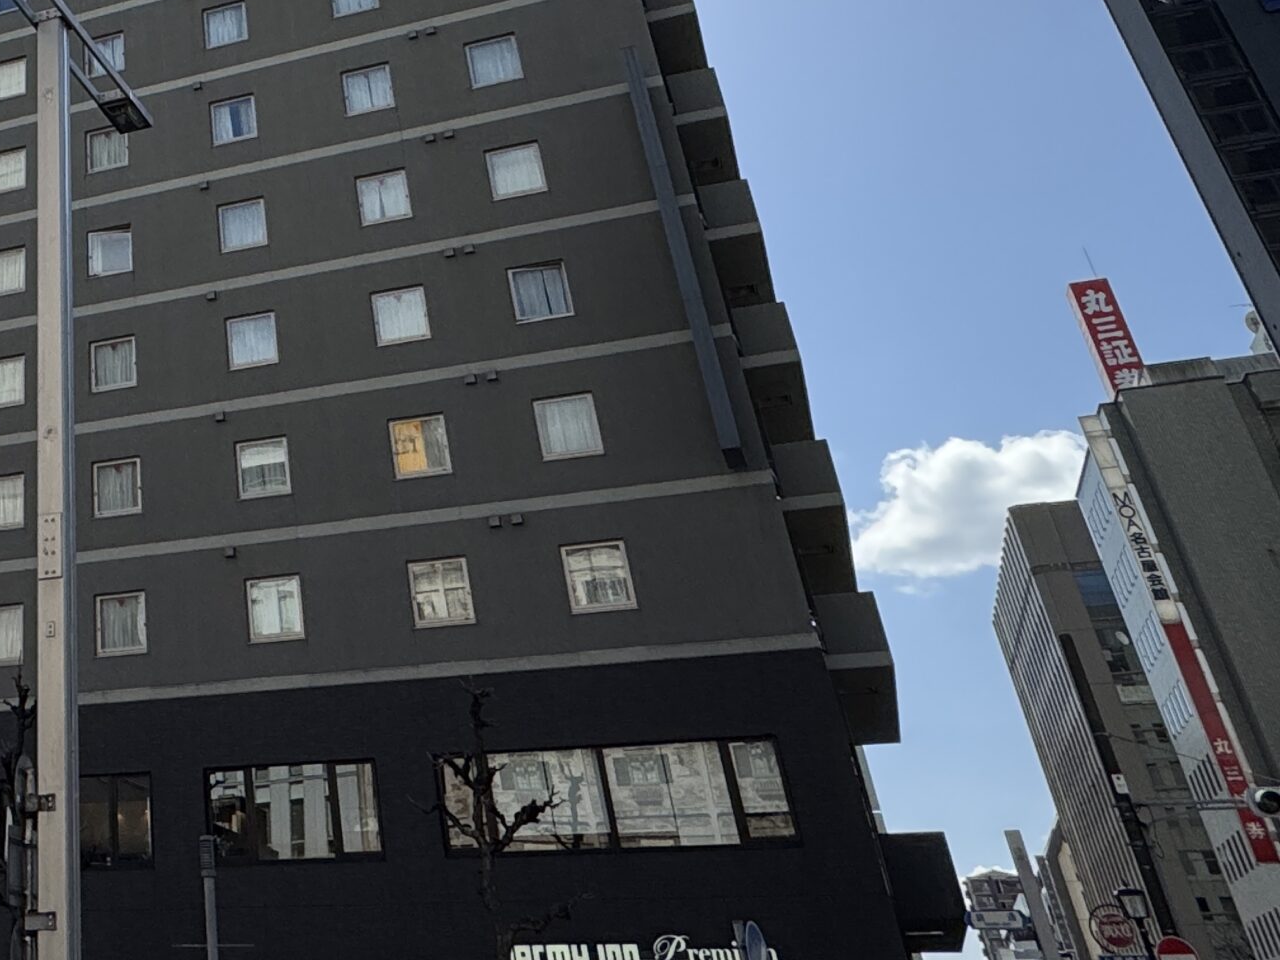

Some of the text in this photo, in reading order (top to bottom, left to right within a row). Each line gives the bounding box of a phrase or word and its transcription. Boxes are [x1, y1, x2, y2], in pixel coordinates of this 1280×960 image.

[1081, 288, 1139, 389] 丸三証券
[1214, 737, 1266, 839] 丸三券
